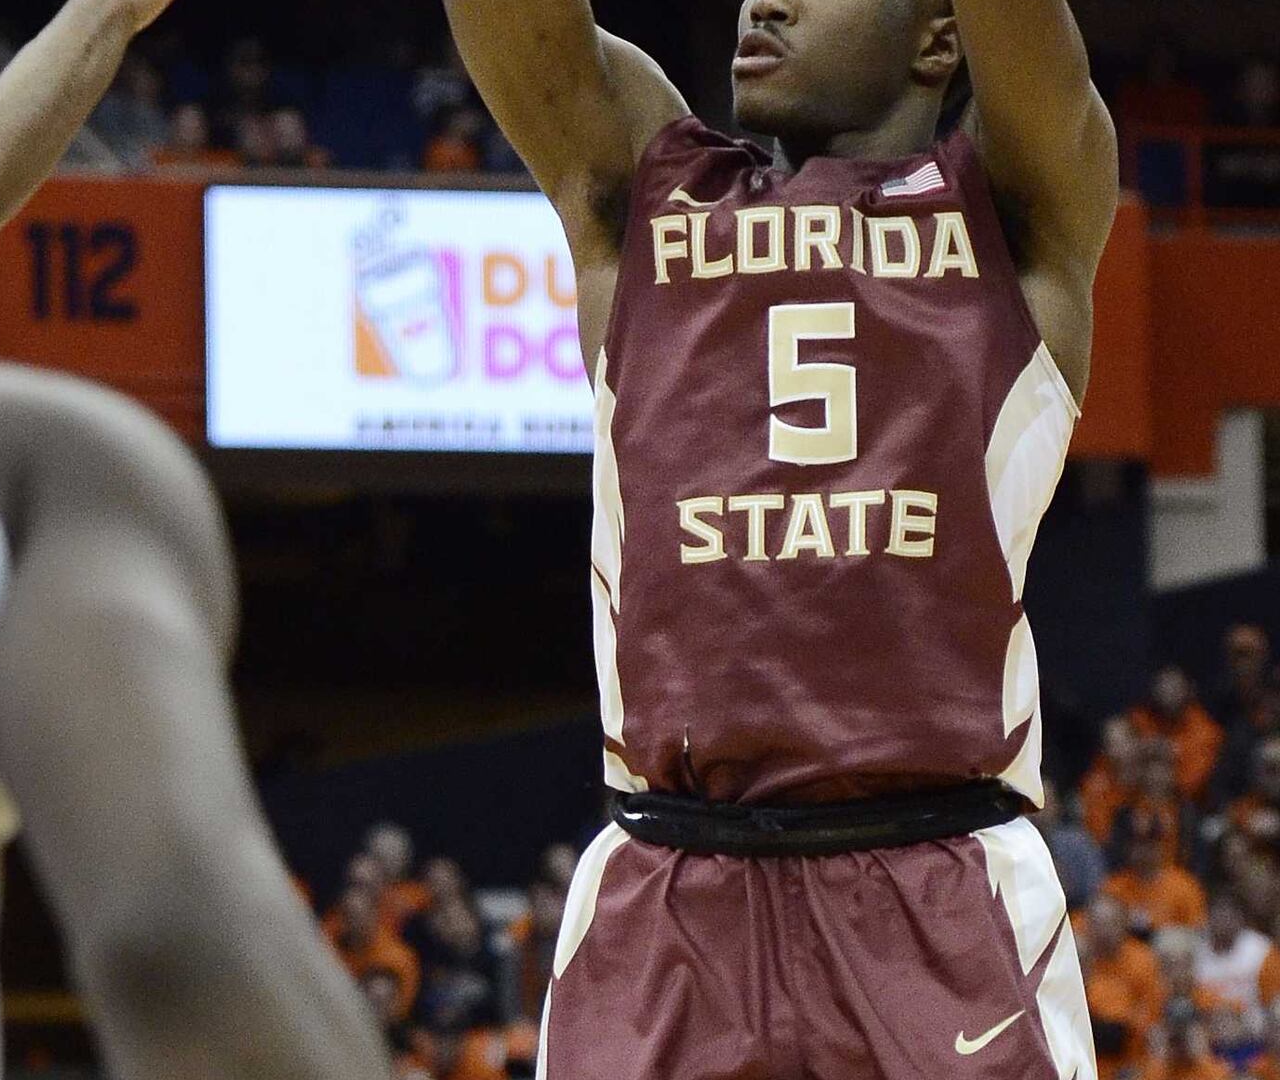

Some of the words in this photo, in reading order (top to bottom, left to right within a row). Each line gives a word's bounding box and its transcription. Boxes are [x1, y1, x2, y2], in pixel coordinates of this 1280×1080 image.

[26, 222, 140, 320] 112
[650, 205, 980, 284] FLORIDA
[768, 302, 857, 466] 5
[676, 490, 938, 563] STATE
